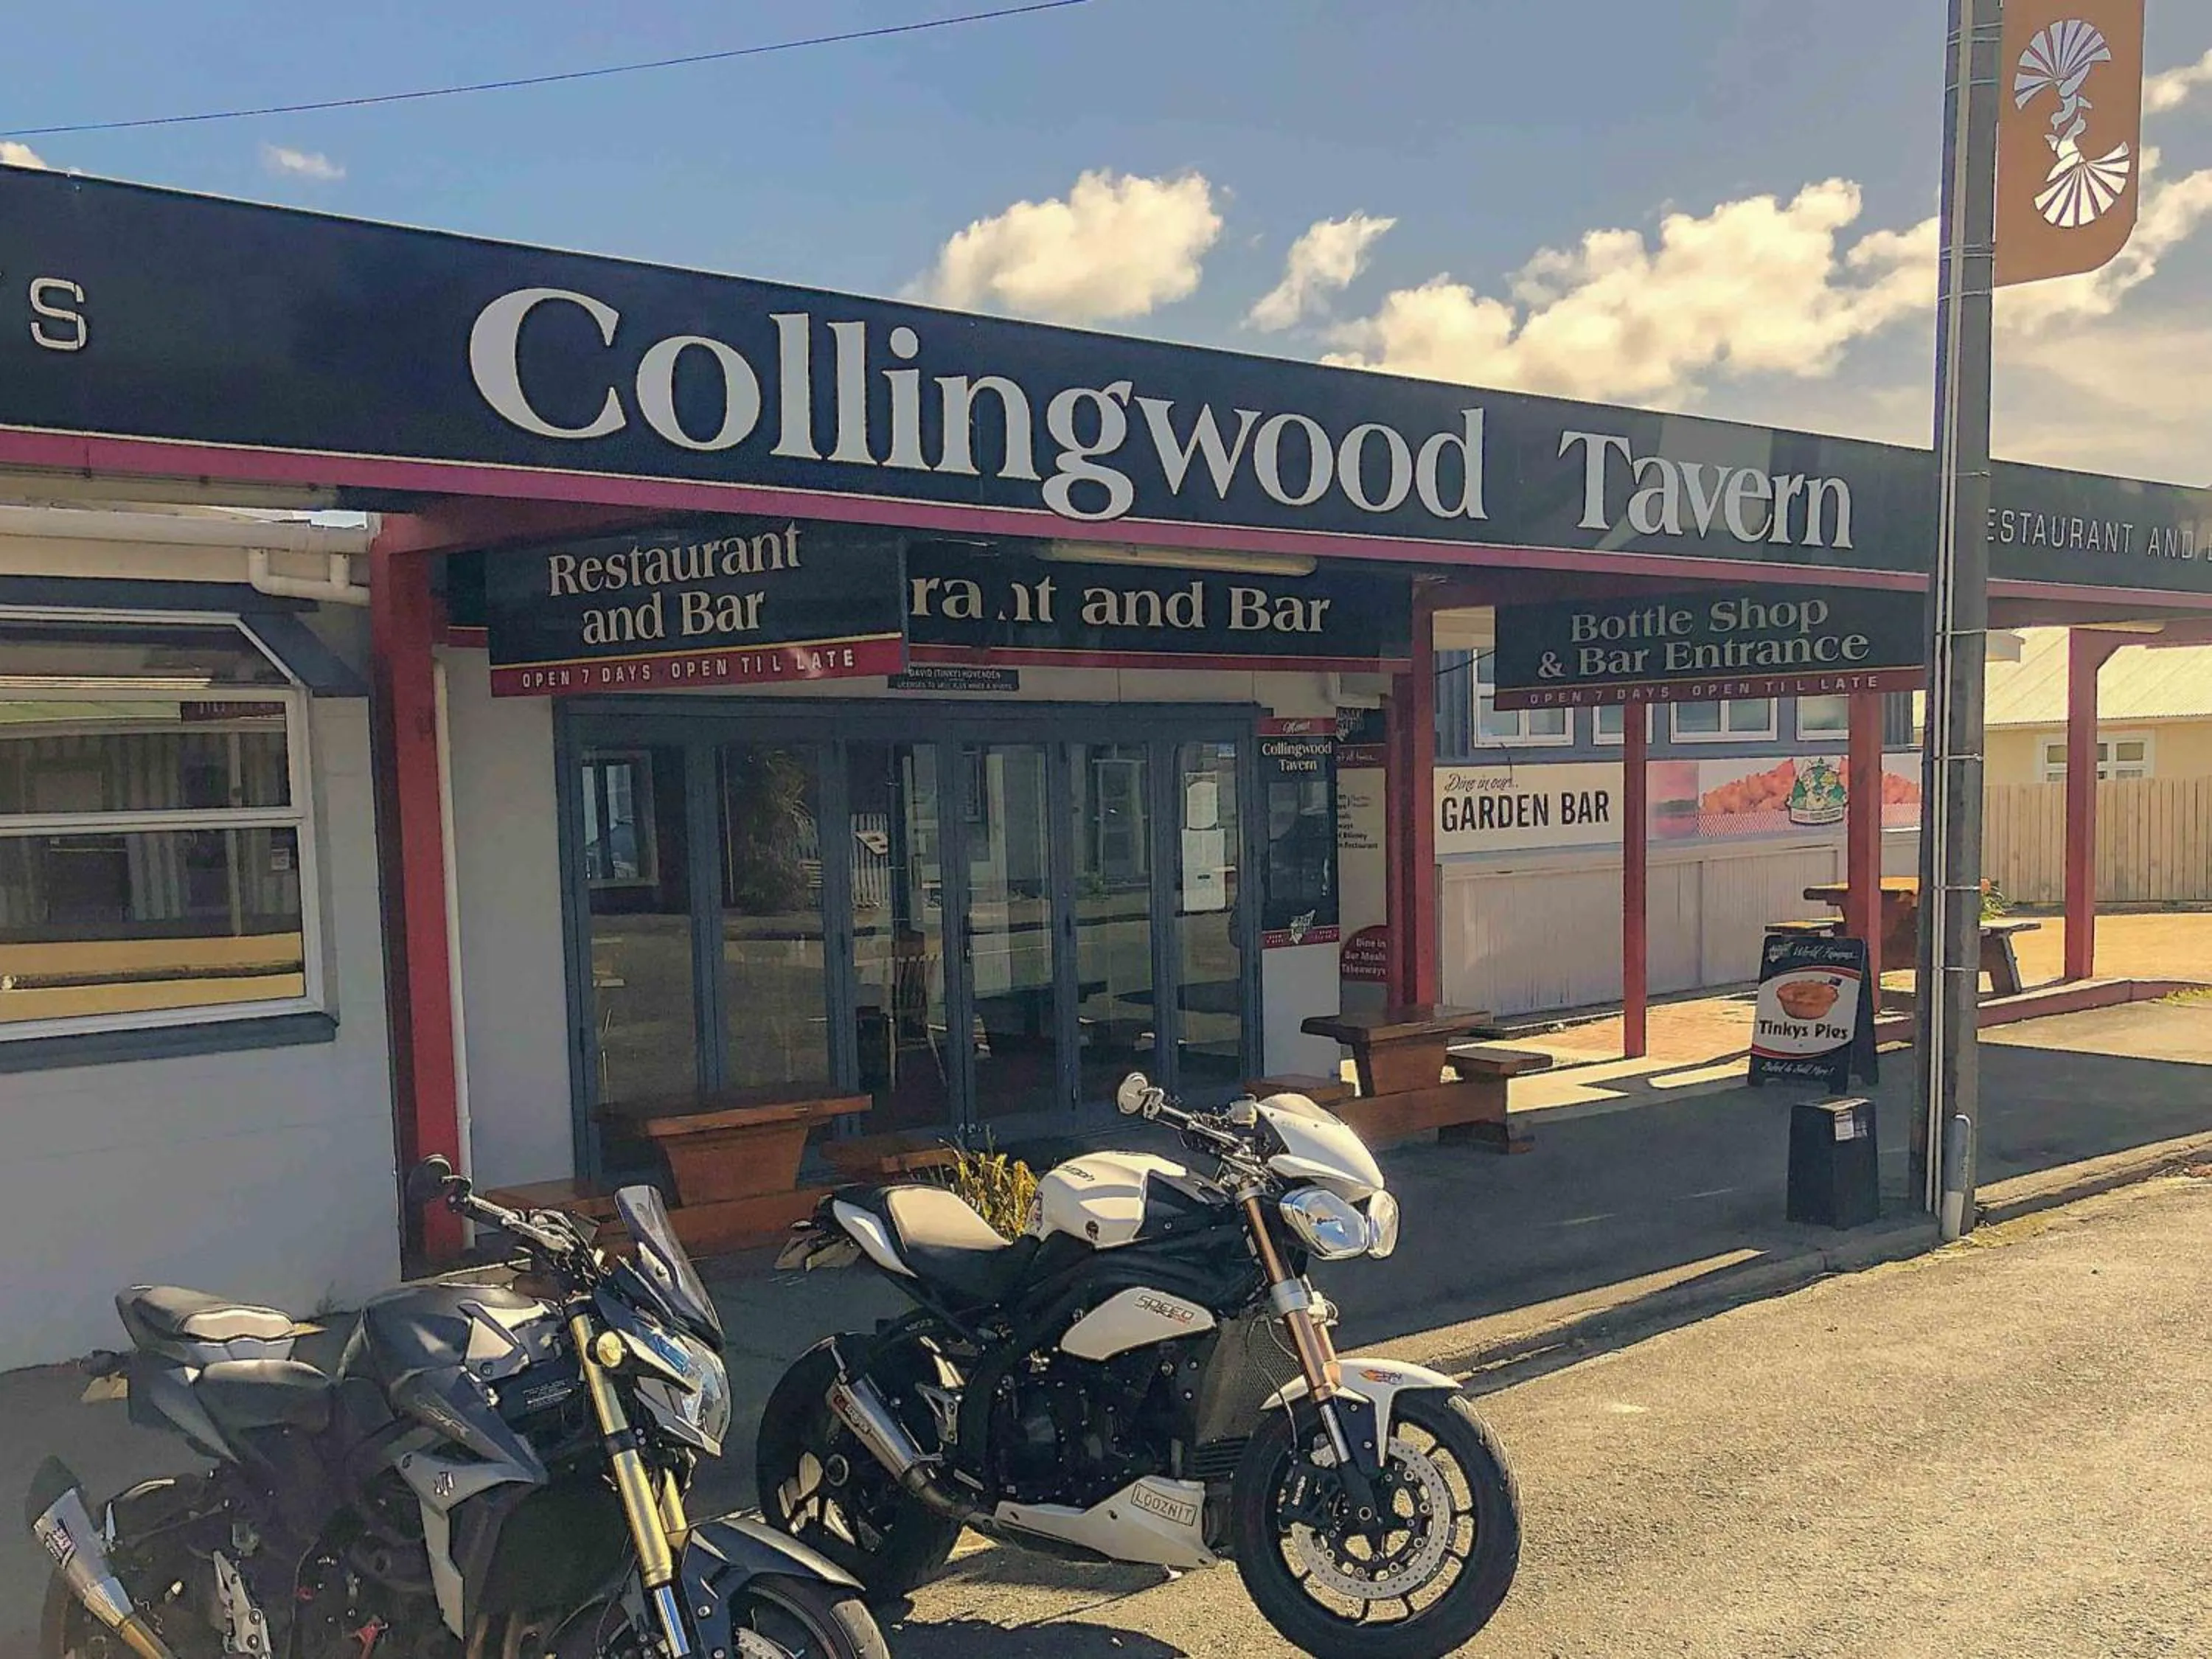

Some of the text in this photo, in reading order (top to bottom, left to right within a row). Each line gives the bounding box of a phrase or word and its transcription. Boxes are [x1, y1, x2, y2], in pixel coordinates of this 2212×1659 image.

[469, 288, 1853, 550] Collingwood Tavern
[1987, 507, 2134, 554] ESTAURANT
[2148, 526, 2194, 559] AND
[548, 521, 801, 597] Restaurant
[582, 589, 765, 644] and Bar
[1082, 580, 1204, 629] and
[1227, 588, 1331, 633] Bar
[1571, 597, 1829, 643] Bottle Shop
[522, 648, 853, 688] OPEN 7 DAYS OPEN TIL LATE
[1537, 633, 1870, 678] & Bar Entrance
[1530, 676, 1878, 705] OPEN 7 DAYS OPEN TIL LATE
[1262, 742, 1333, 758] Collingwood
[1279, 759, 1318, 771] Tavern
[1441, 790, 1610, 832] GARDEN BAR
[1759, 1020, 1849, 1040] Tinkys Pies
